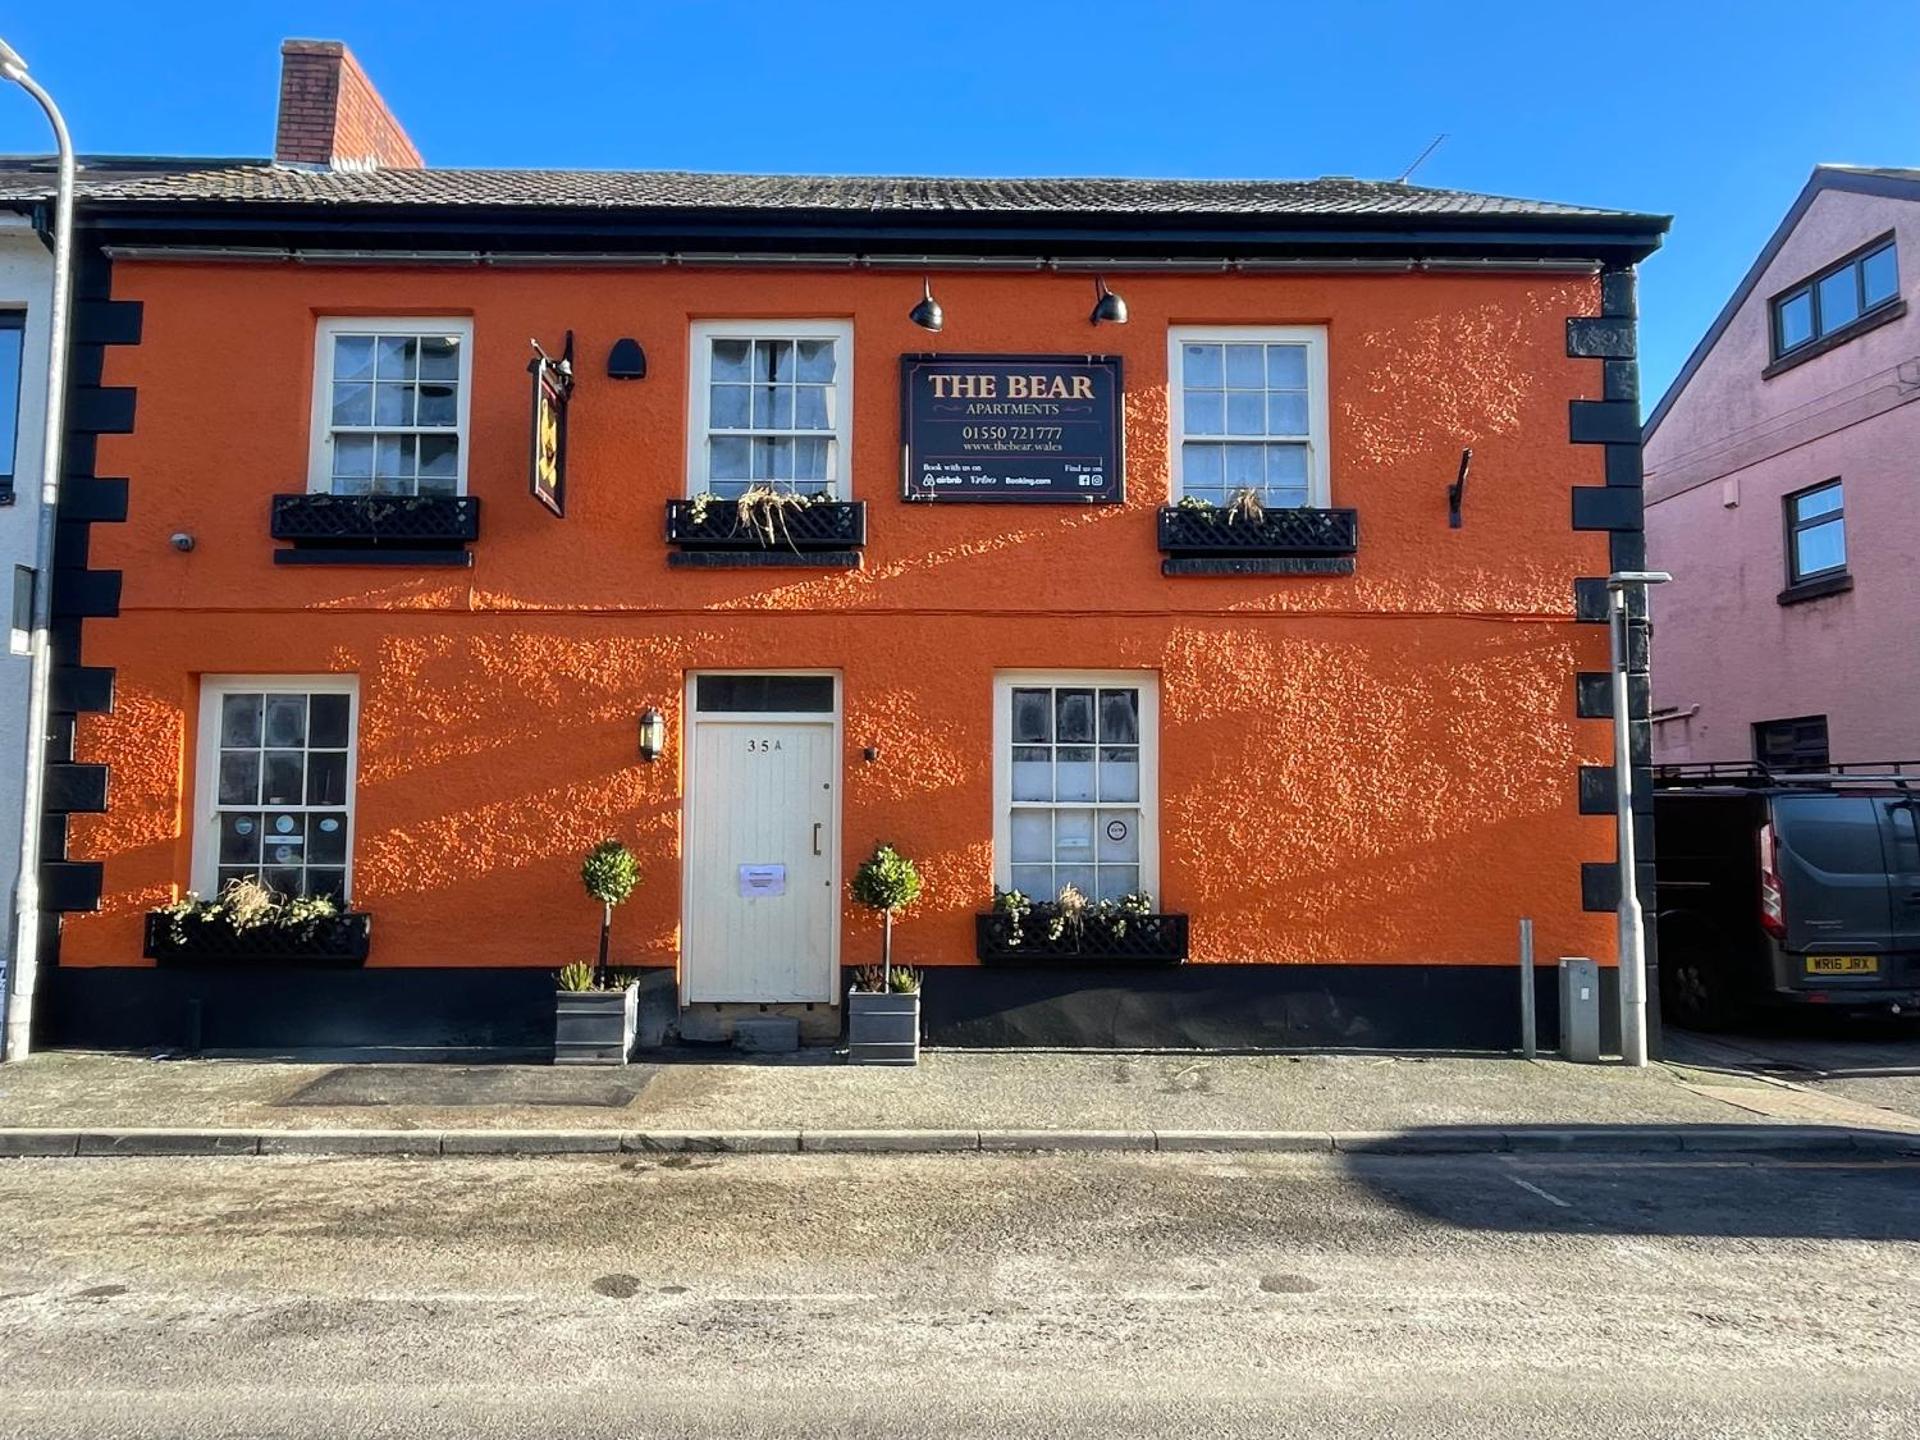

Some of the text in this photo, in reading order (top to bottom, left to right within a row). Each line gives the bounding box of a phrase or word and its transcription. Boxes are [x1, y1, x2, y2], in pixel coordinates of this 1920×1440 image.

[928, 375, 1095, 399] THE BEAR
[966, 403, 1060, 415] APARTMENTS
[962, 426, 1063, 440] 01550 721777
[963, 441, 1063, 451] www.thebear.wales
[923, 463, 942, 471] Book
[944, 463, 961, 471] with
[1065, 464, 1081, 472] Find
[936, 475, 963, 484] airbnb
[1005, 477, 1052, 486] Booking.com
